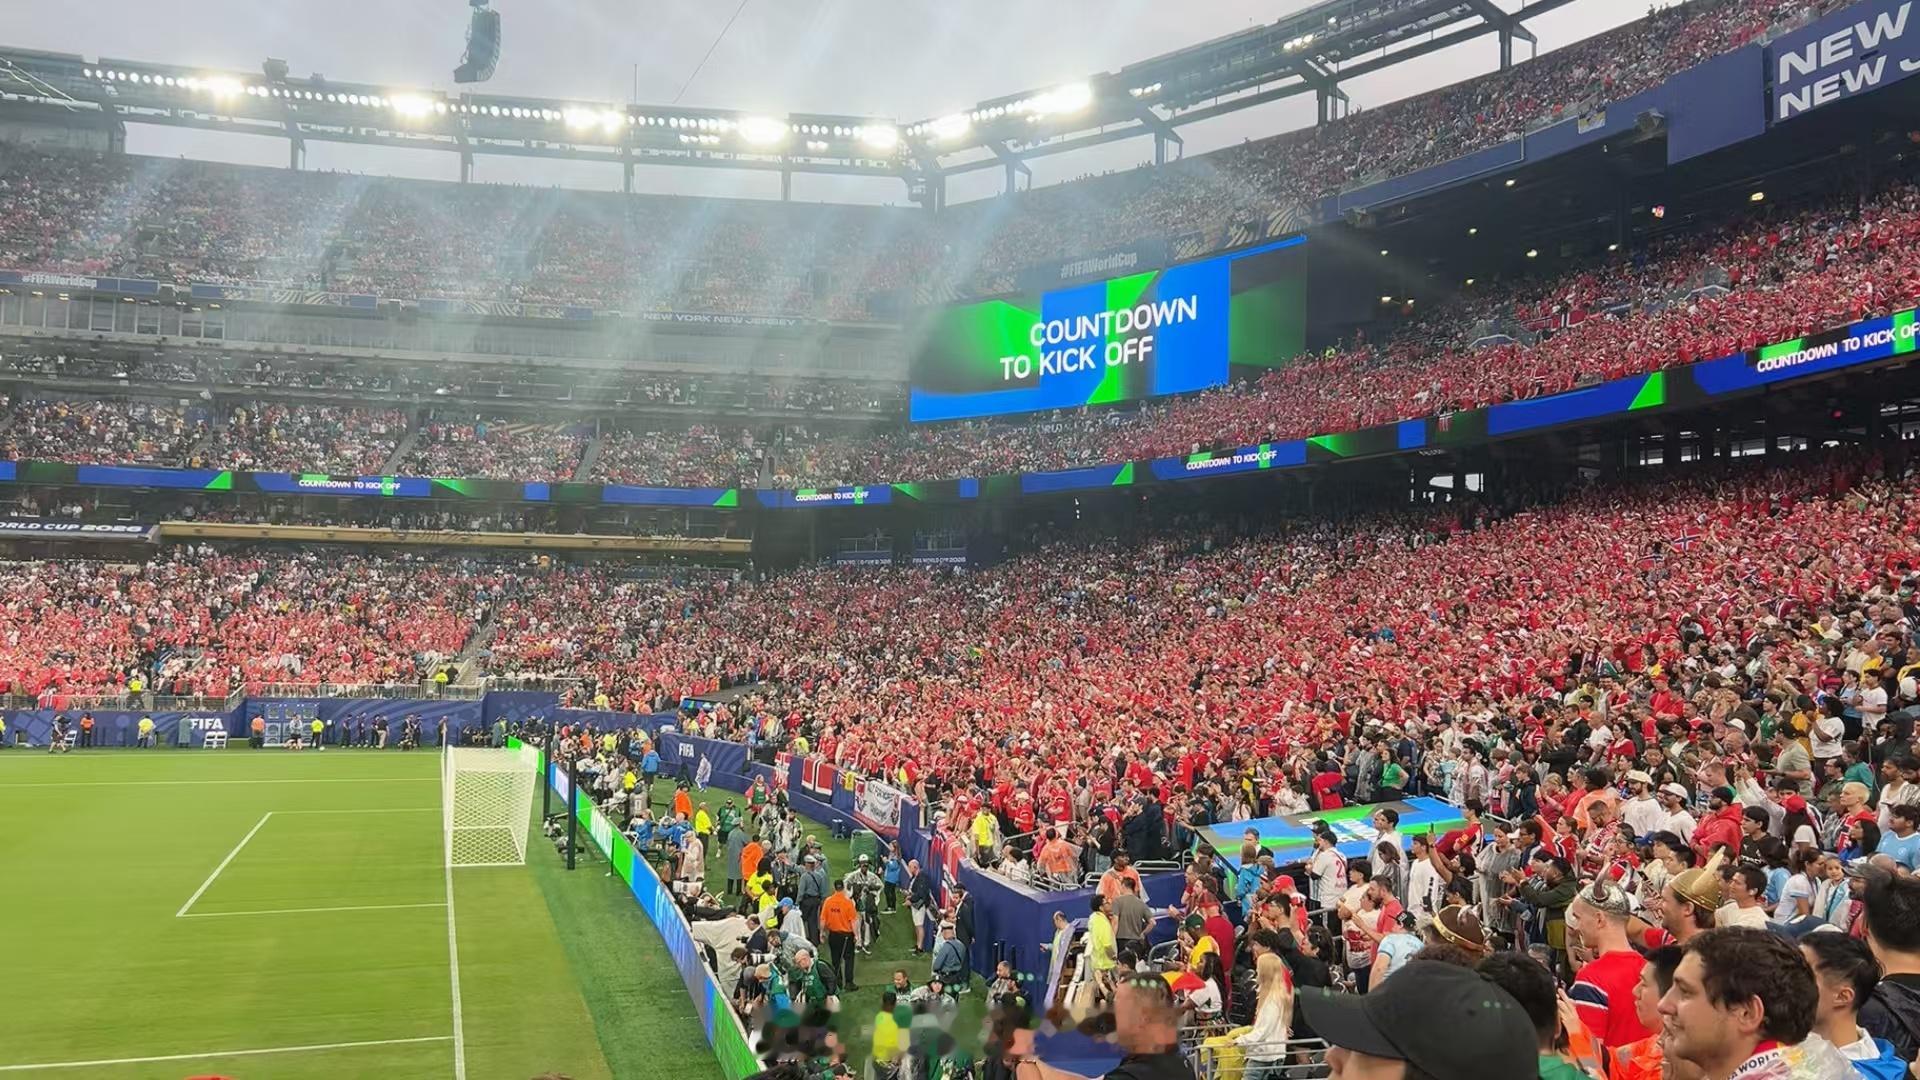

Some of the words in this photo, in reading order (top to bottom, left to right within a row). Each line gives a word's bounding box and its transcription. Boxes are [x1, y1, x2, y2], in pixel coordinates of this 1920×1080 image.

[1780, 1, 1912, 85] NEW
[1780, 55, 1887, 119] NEW
[1060, 252, 1137, 279] #FIFAWorldCup
[22, 272, 98, 289] #FIFAWorldCup
[643, 313, 673, 321] NEW
[676, 313, 711, 323] YORK
[714, 315, 743, 324] NEW
[745, 318, 795, 326] JERSEY
[1030, 295, 1197, 347] COUNTDOWN
[1757, 342, 1838, 372] COUNTDOWN
[1842, 337, 1860, 352] TO
[1864, 327, 1896, 348] KICK
[1901, 321, 1920, 339] OF
[1000, 354, 1031, 380] TO
[1039, 344, 1096, 376] KICK
[1104, 335, 1153, 367] OFF
[1186, 457, 1231, 470] COUNTDOWN
[1232, 455, 1242, 464] TO
[1244, 453, 1261, 463] KICK
[1262, 450, 1277, 460] OFF
[299, 480, 351, 488] COUNTDOWN
[354, 481, 364, 489] TO
[365, 481, 384, 489] KICK
[386, 482, 401, 490] OFF
[44, 523, 80, 531] CUP
[80, 524, 143, 532] 2026
[190, 718, 224, 730] FIFA
[679, 742, 695, 758] FIFA
